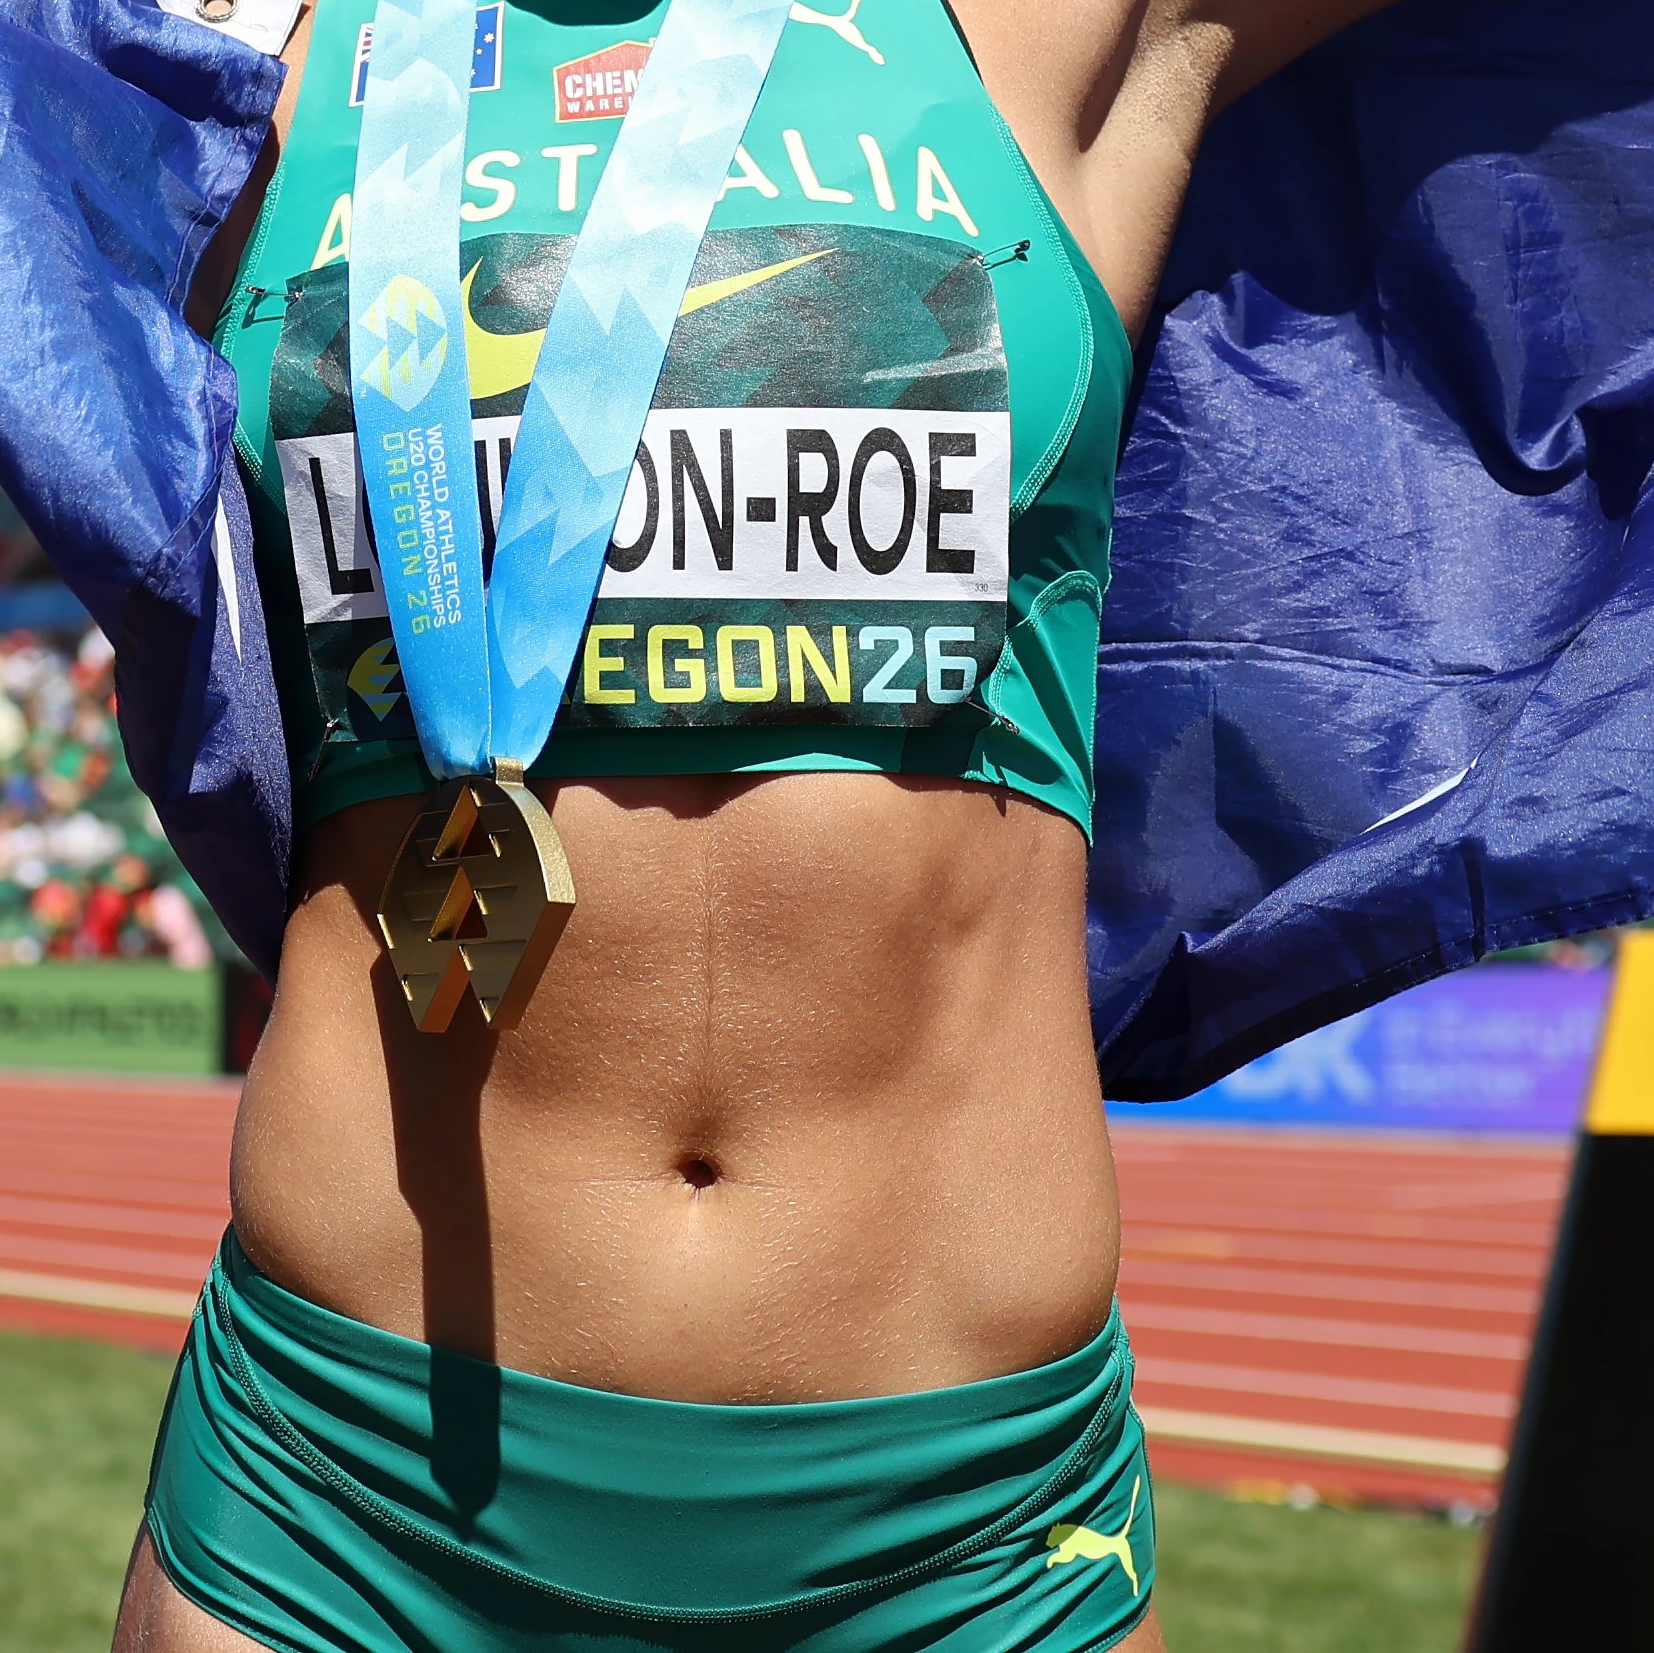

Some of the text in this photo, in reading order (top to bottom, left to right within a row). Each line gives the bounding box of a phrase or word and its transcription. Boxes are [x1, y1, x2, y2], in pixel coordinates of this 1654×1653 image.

[564, 68, 645, 99] CHEM
[308, 128, 979, 271] ASTALIA
[382, 431, 432, 635] OREGON 26
[408, 428, 447, 629] U20 CHAMPIONSHIPS
[425, 423, 463, 625] WORLD ATHLETICS
[560, 623, 978, 705] EGON26
